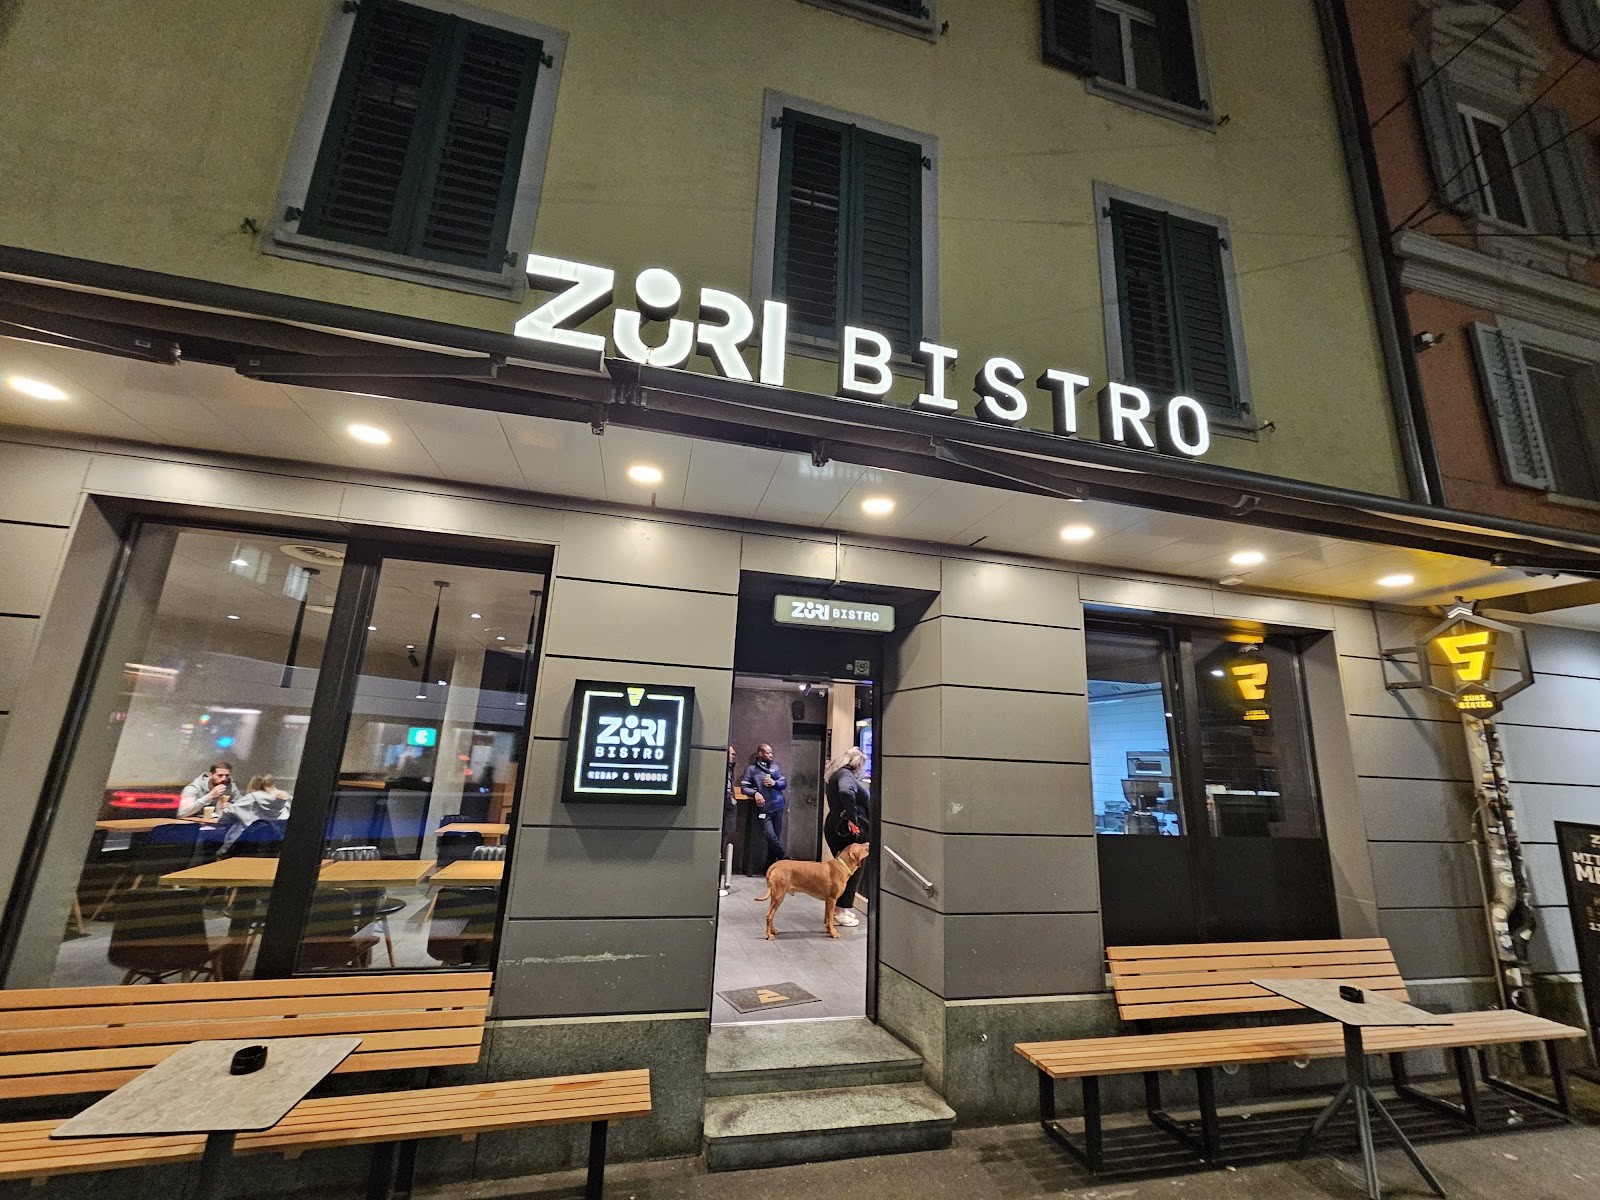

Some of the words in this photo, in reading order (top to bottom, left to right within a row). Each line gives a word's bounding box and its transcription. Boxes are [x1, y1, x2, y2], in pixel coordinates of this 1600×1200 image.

[842, 325, 1211, 457] BISTRO
[832, 608, 880, 622] BISTRO
[595, 746, 665, 760] BISTRO
[587, 771, 619, 780] KEBAP
